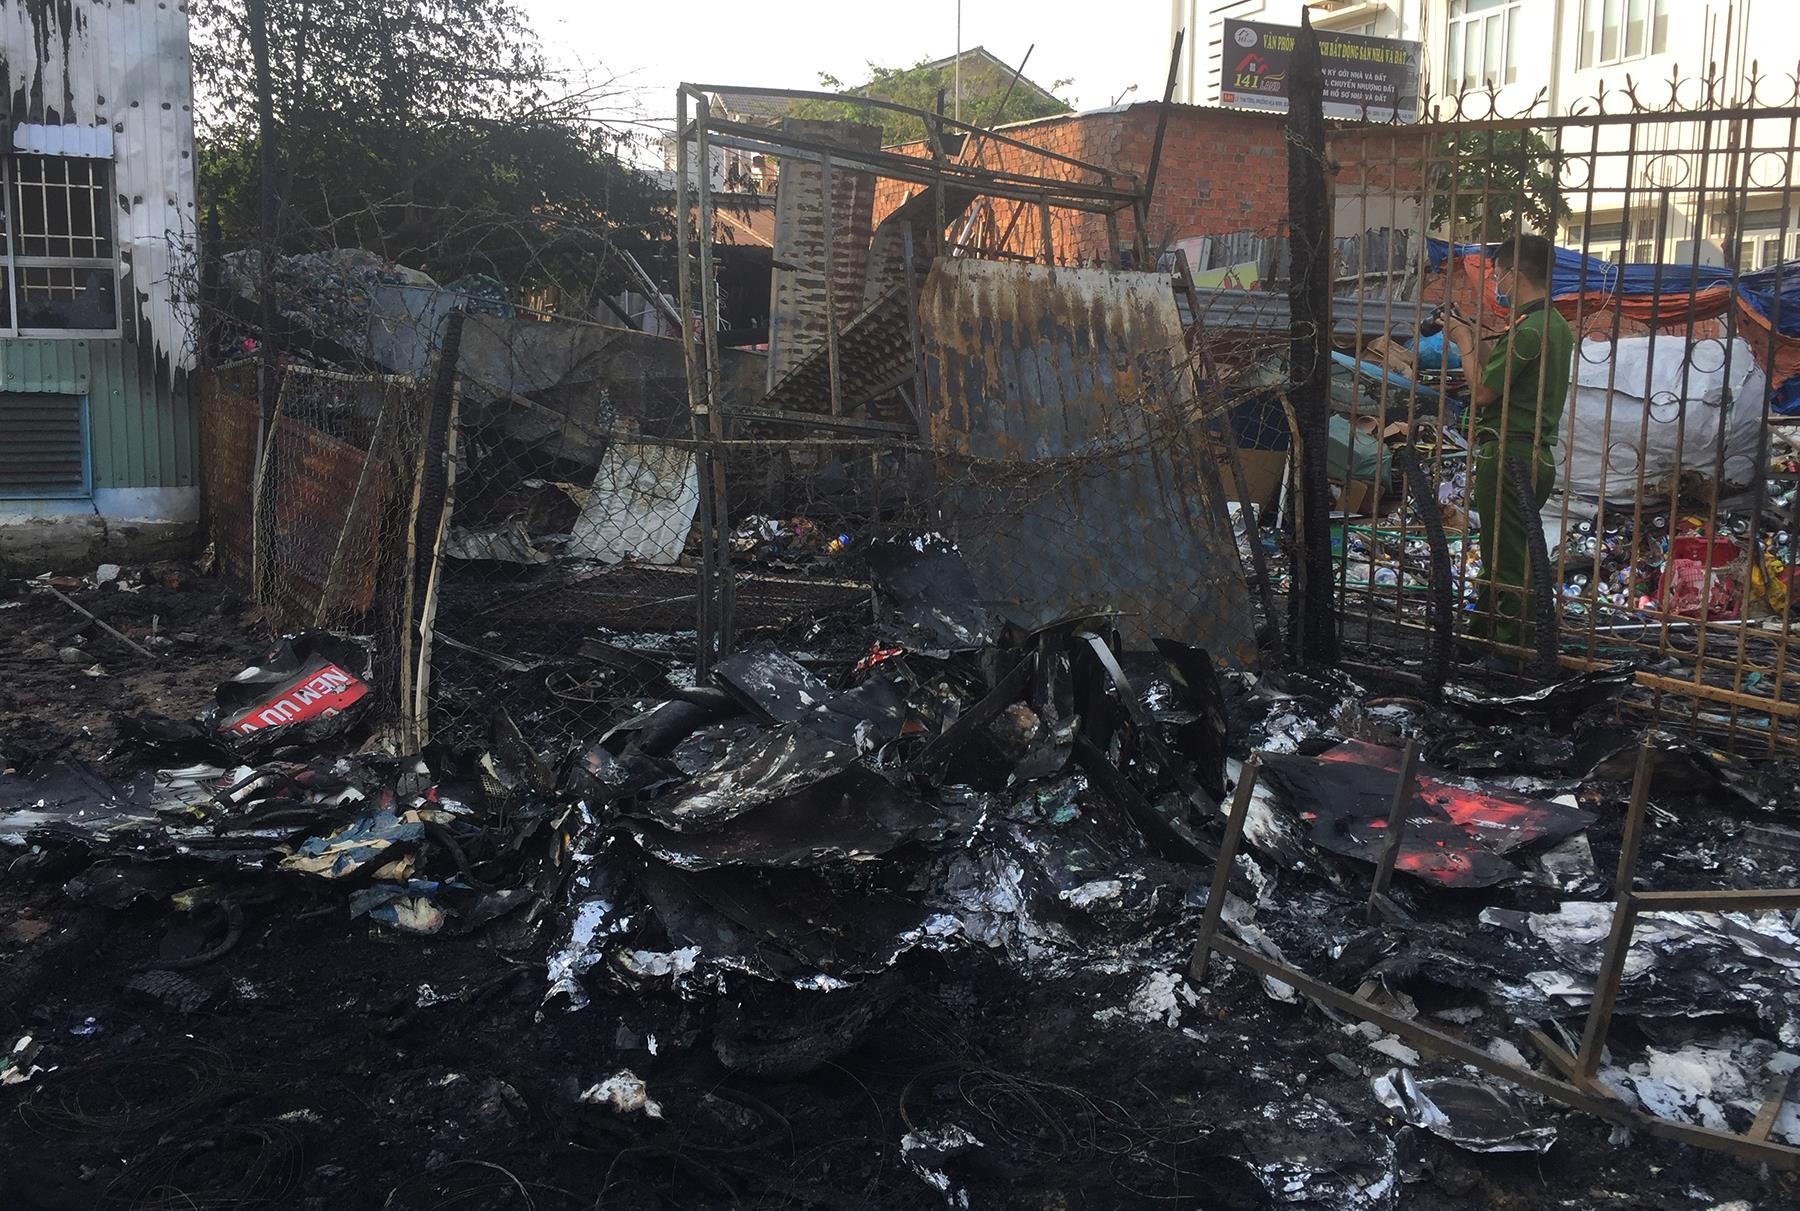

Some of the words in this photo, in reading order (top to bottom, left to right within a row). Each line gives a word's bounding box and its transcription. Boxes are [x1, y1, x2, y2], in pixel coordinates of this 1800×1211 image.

[1277, 33, 1295, 52] PHÒN
[1233, 73, 1259, 89] 141
[1350, 71, 1363, 79] NHÀ
[1364, 72, 1373, 81] VÀ
[1374, 73, 1387, 82] ĐẤT
[1383, 84, 1395, 93] ĐẤT
